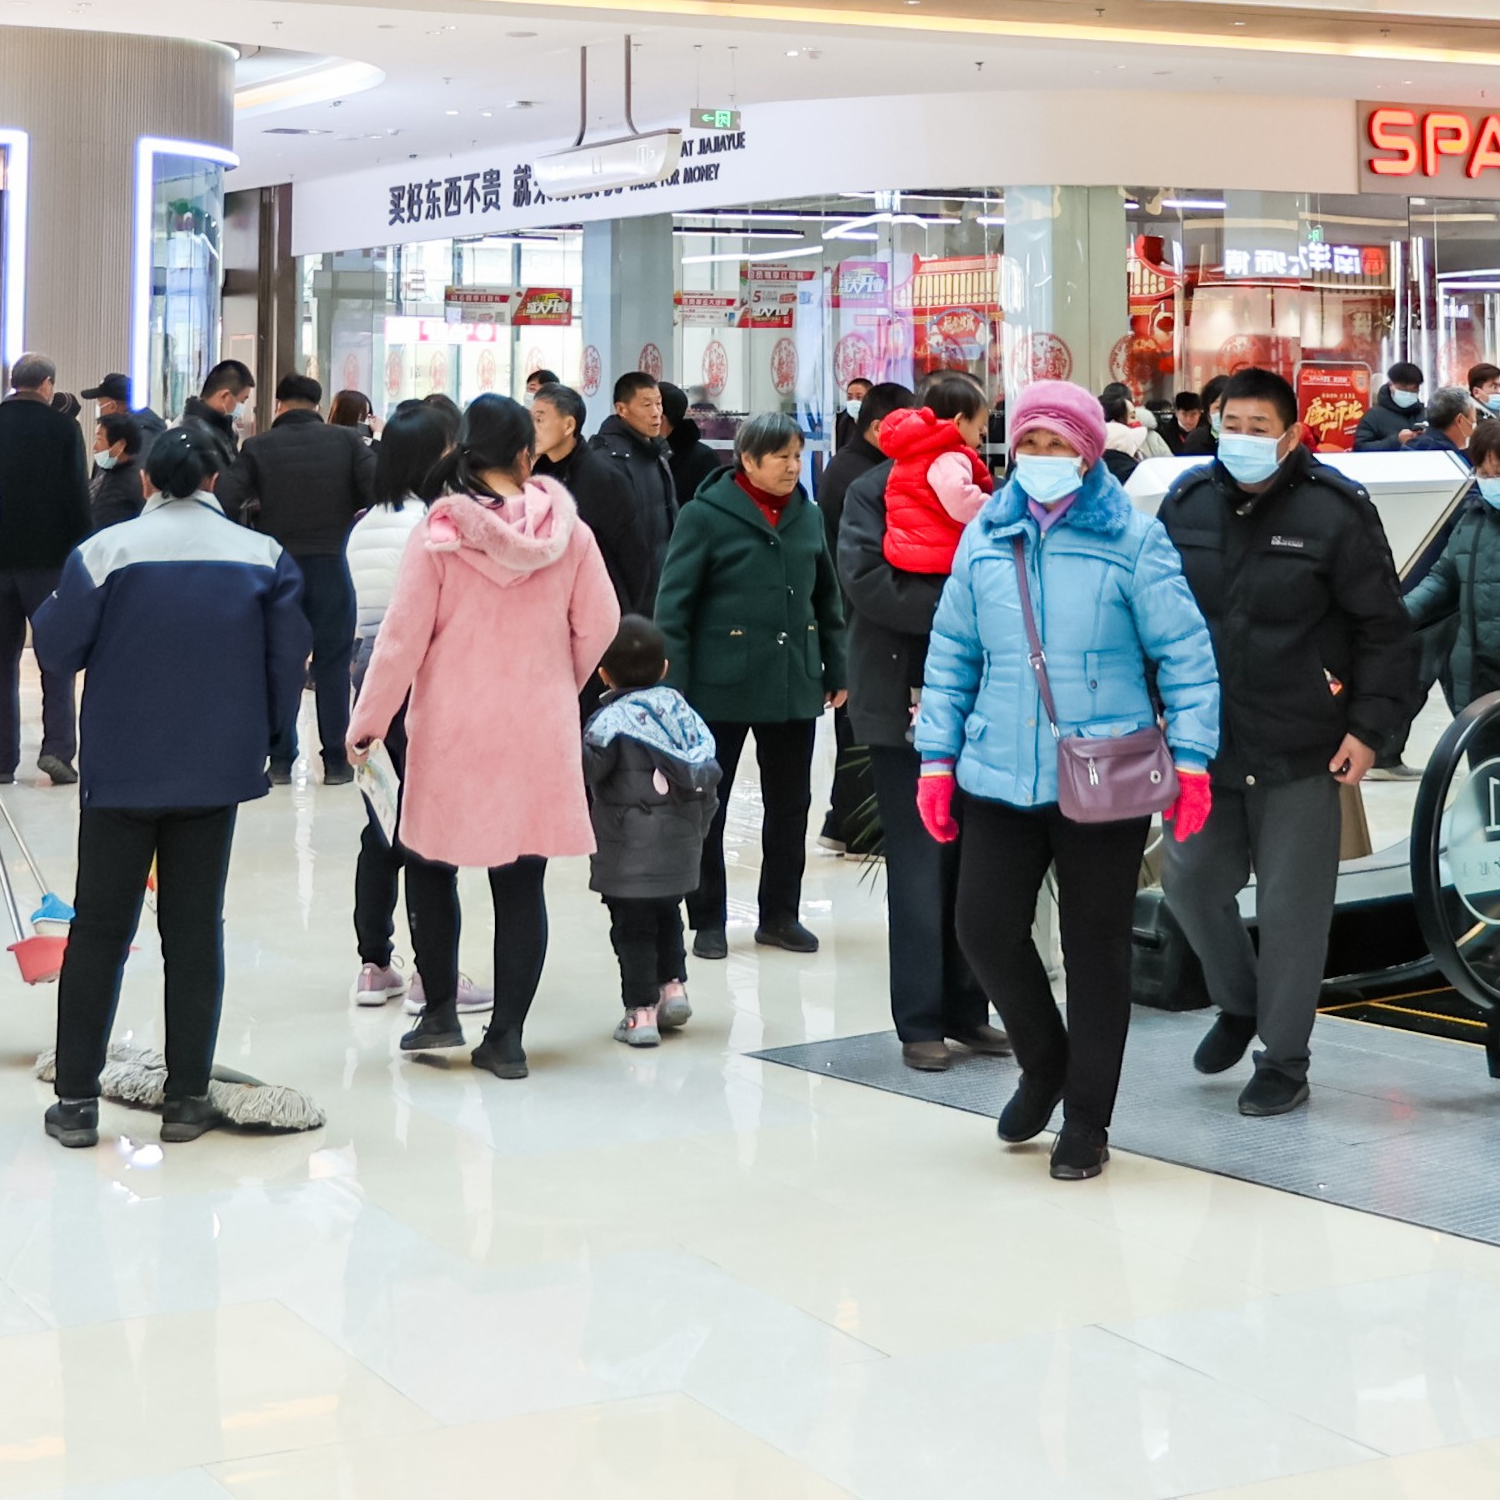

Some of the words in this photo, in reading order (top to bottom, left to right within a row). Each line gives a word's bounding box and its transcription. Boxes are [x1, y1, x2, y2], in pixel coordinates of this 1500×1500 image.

[683, 162, 721, 185] MONEY
[388, 168, 501, 226] 买好东西不贵
